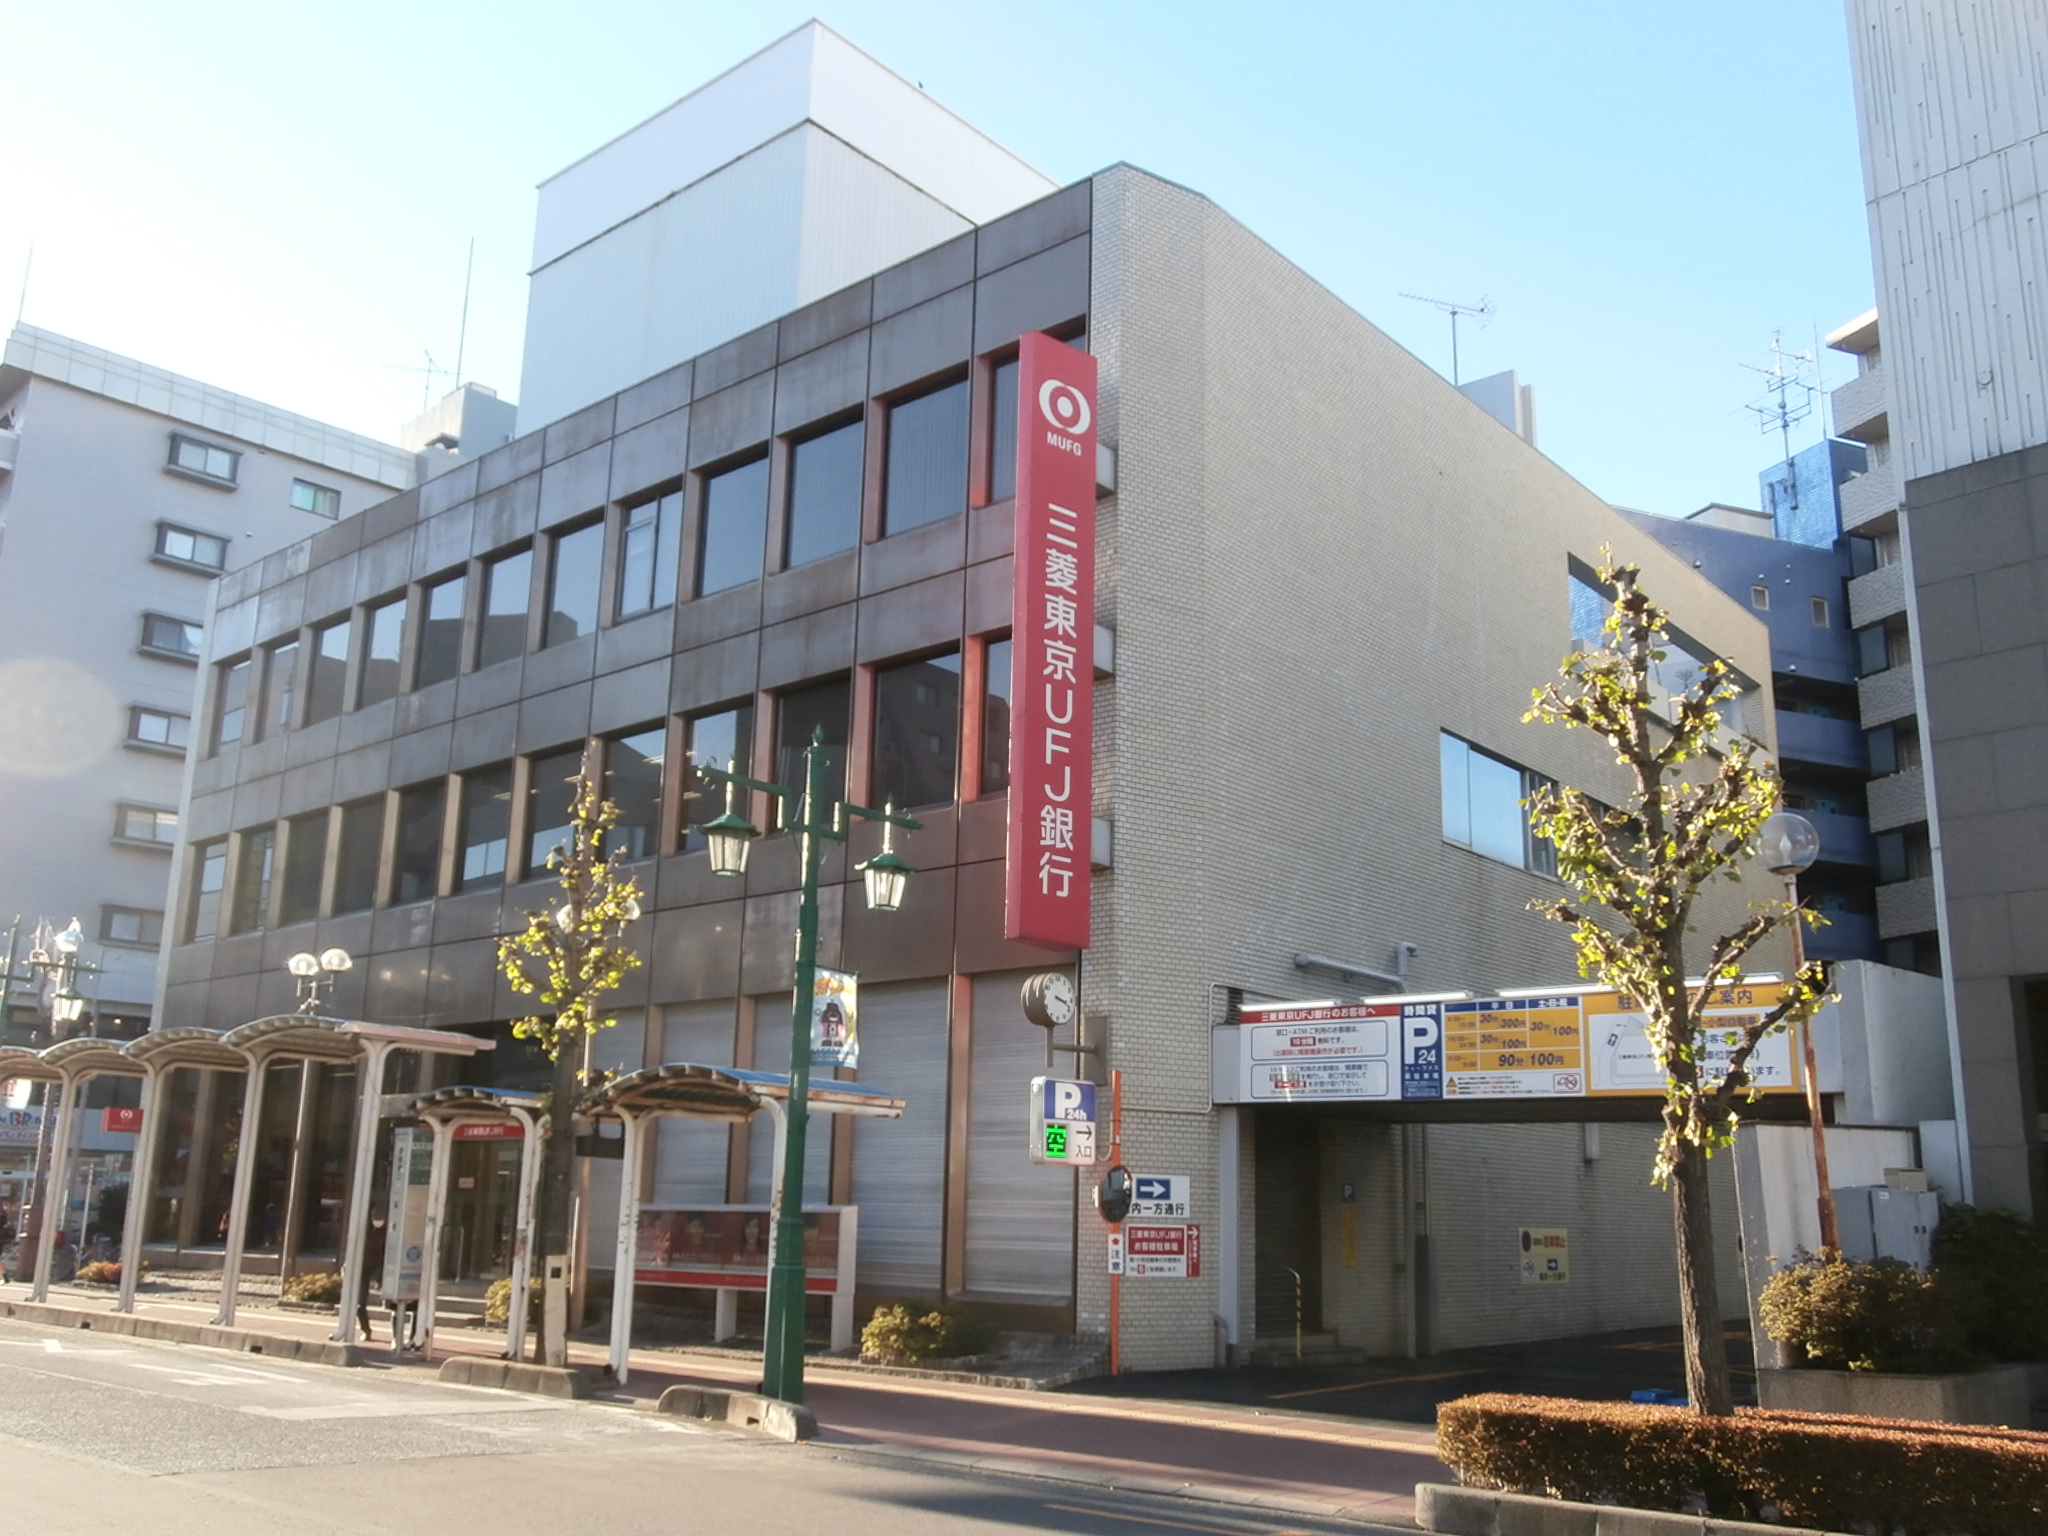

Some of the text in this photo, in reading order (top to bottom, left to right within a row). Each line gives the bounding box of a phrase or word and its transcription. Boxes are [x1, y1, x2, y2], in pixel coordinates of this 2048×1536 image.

[1047, 431, 1082, 456] MUFG
[1039, 502, 1078, 898] 三菱東京UFJ銀行
[1261, 1006, 1376, 1022] 三菱東京UFJ銀行のお客様へ
[1404, 1003, 1437, 1016] 時間貸
[1403, 1016, 1438, 1065] P
[1418, 1049, 1436, 1064] 24
[1499, 1052, 1564, 1067] 90分 100円
[1055, 1082, 1087, 1121] P 24h
[1045, 1124, 1067, 1158] 空
[1076, 1145, 1092, 1158] 入口
[1129, 1202, 1185, 1216] 内一方通行
